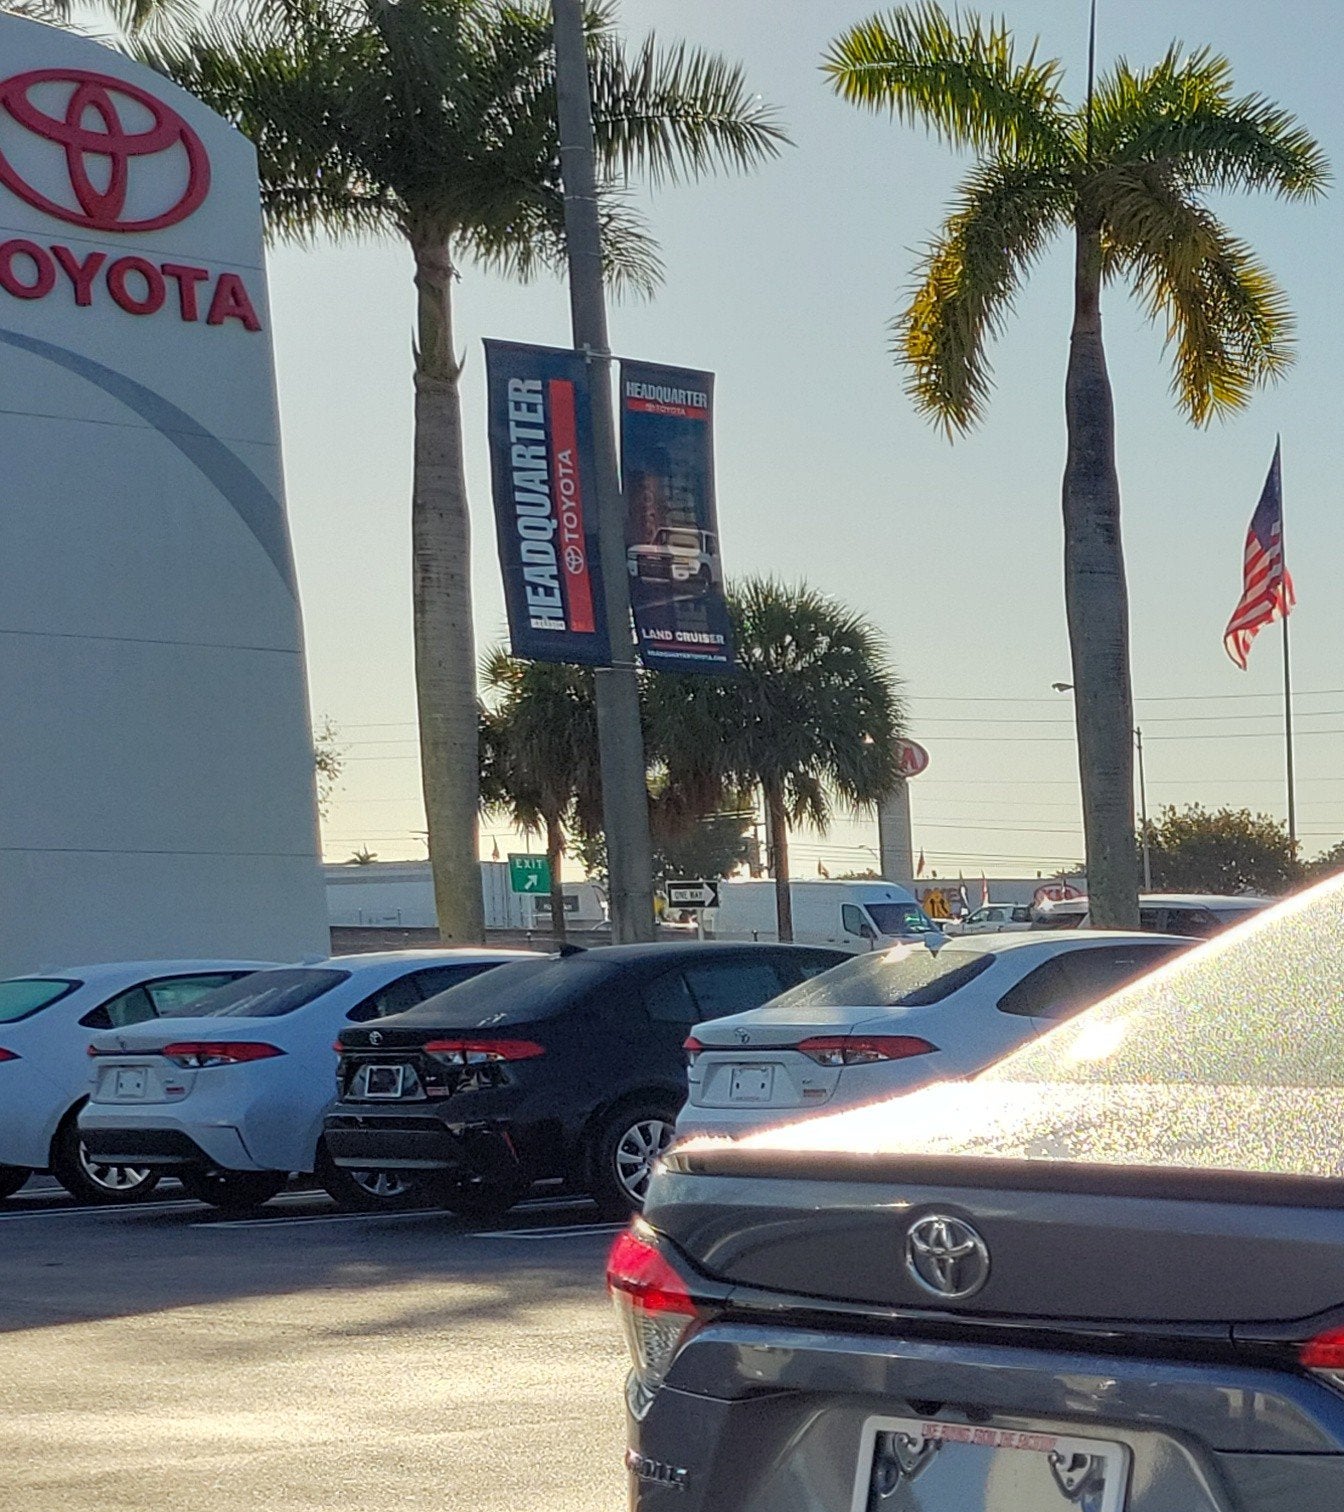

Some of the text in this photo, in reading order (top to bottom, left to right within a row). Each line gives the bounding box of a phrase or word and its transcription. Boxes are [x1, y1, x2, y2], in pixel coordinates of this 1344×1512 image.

[0, 239, 262, 331] OYOTA
[626, 381, 708, 408] HEADQUARTER
[507, 377, 567, 632] HEADQUARTER
[556, 449, 575, 542] TOYOTA
[641, 627, 725, 645] LAND CRUISER
[515, 858, 543, 870] EXIT
[674, 890, 703, 900] ONE WAY
